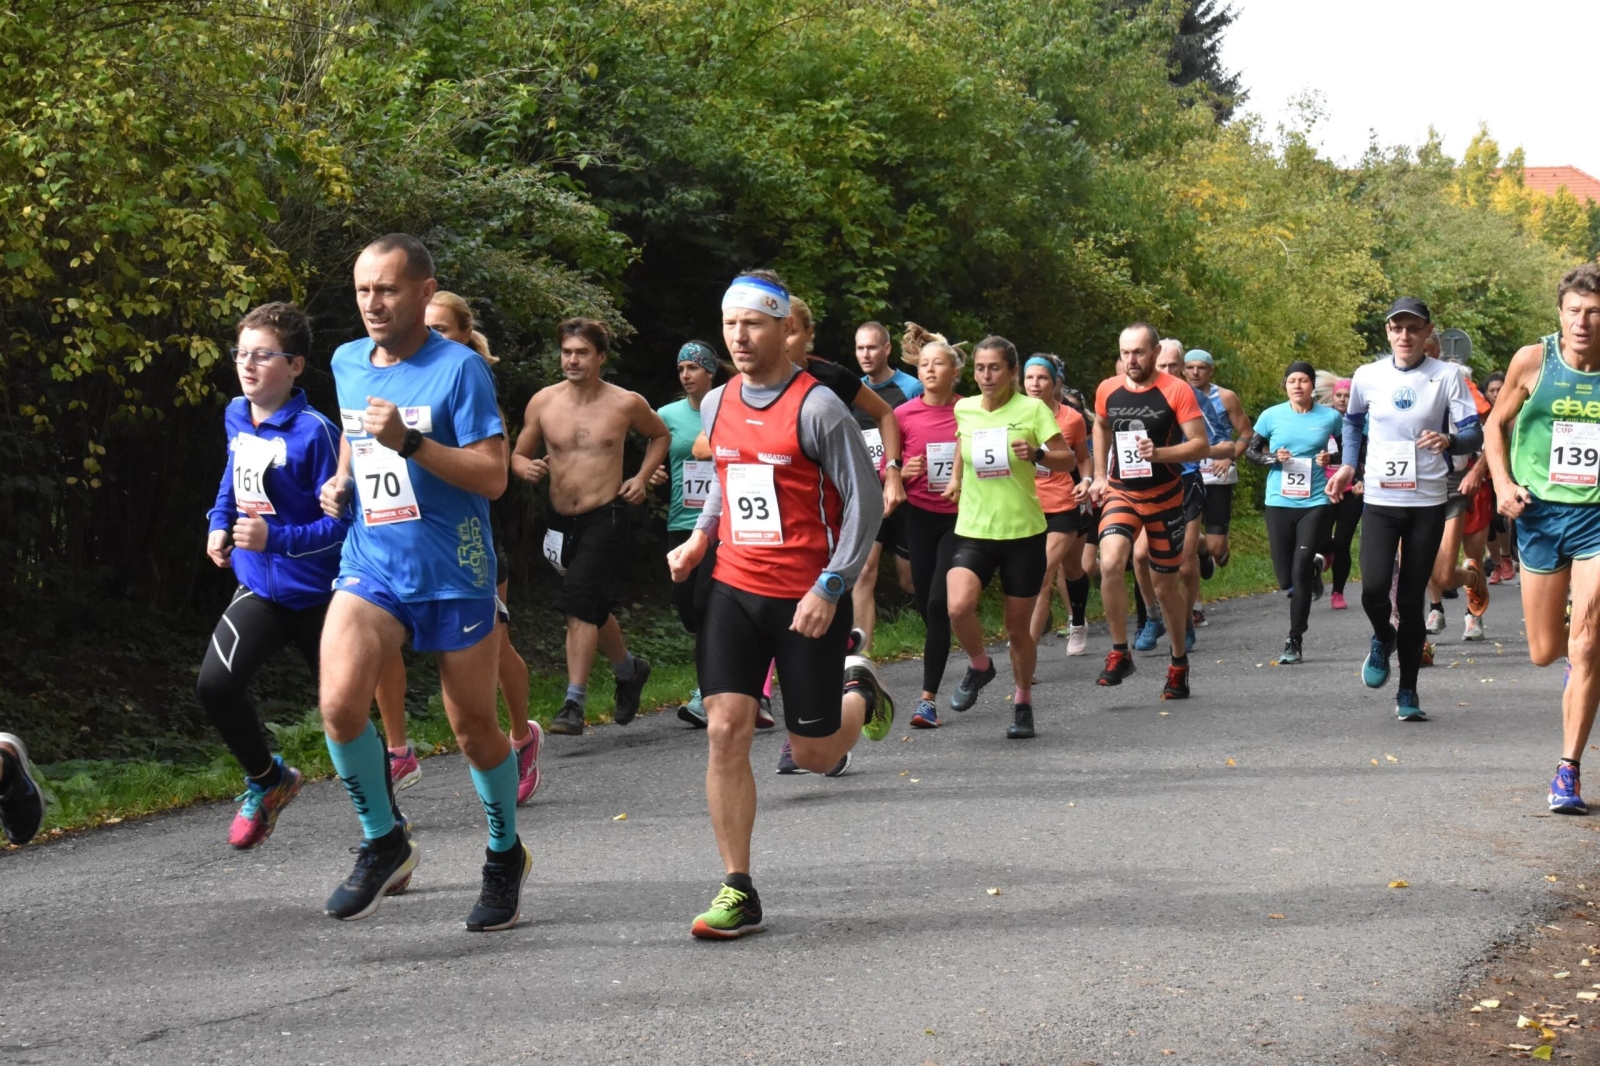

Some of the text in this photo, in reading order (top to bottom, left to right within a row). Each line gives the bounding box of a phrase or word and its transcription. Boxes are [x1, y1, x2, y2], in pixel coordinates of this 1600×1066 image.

[758, 452, 792, 462] MARATON
[984, 448, 995, 465] 5
[1123, 450, 1144, 464] 39
[1553, 446, 1599, 467] 139
[933, 461, 954, 477] 73
[1385, 461, 1409, 476] 37
[235, 466, 262, 494] 161
[365, 471, 401, 499] 70
[1287, 472, 1306, 486] 52
[737, 496, 770, 520] 93
[546, 547, 560, 566] 22
